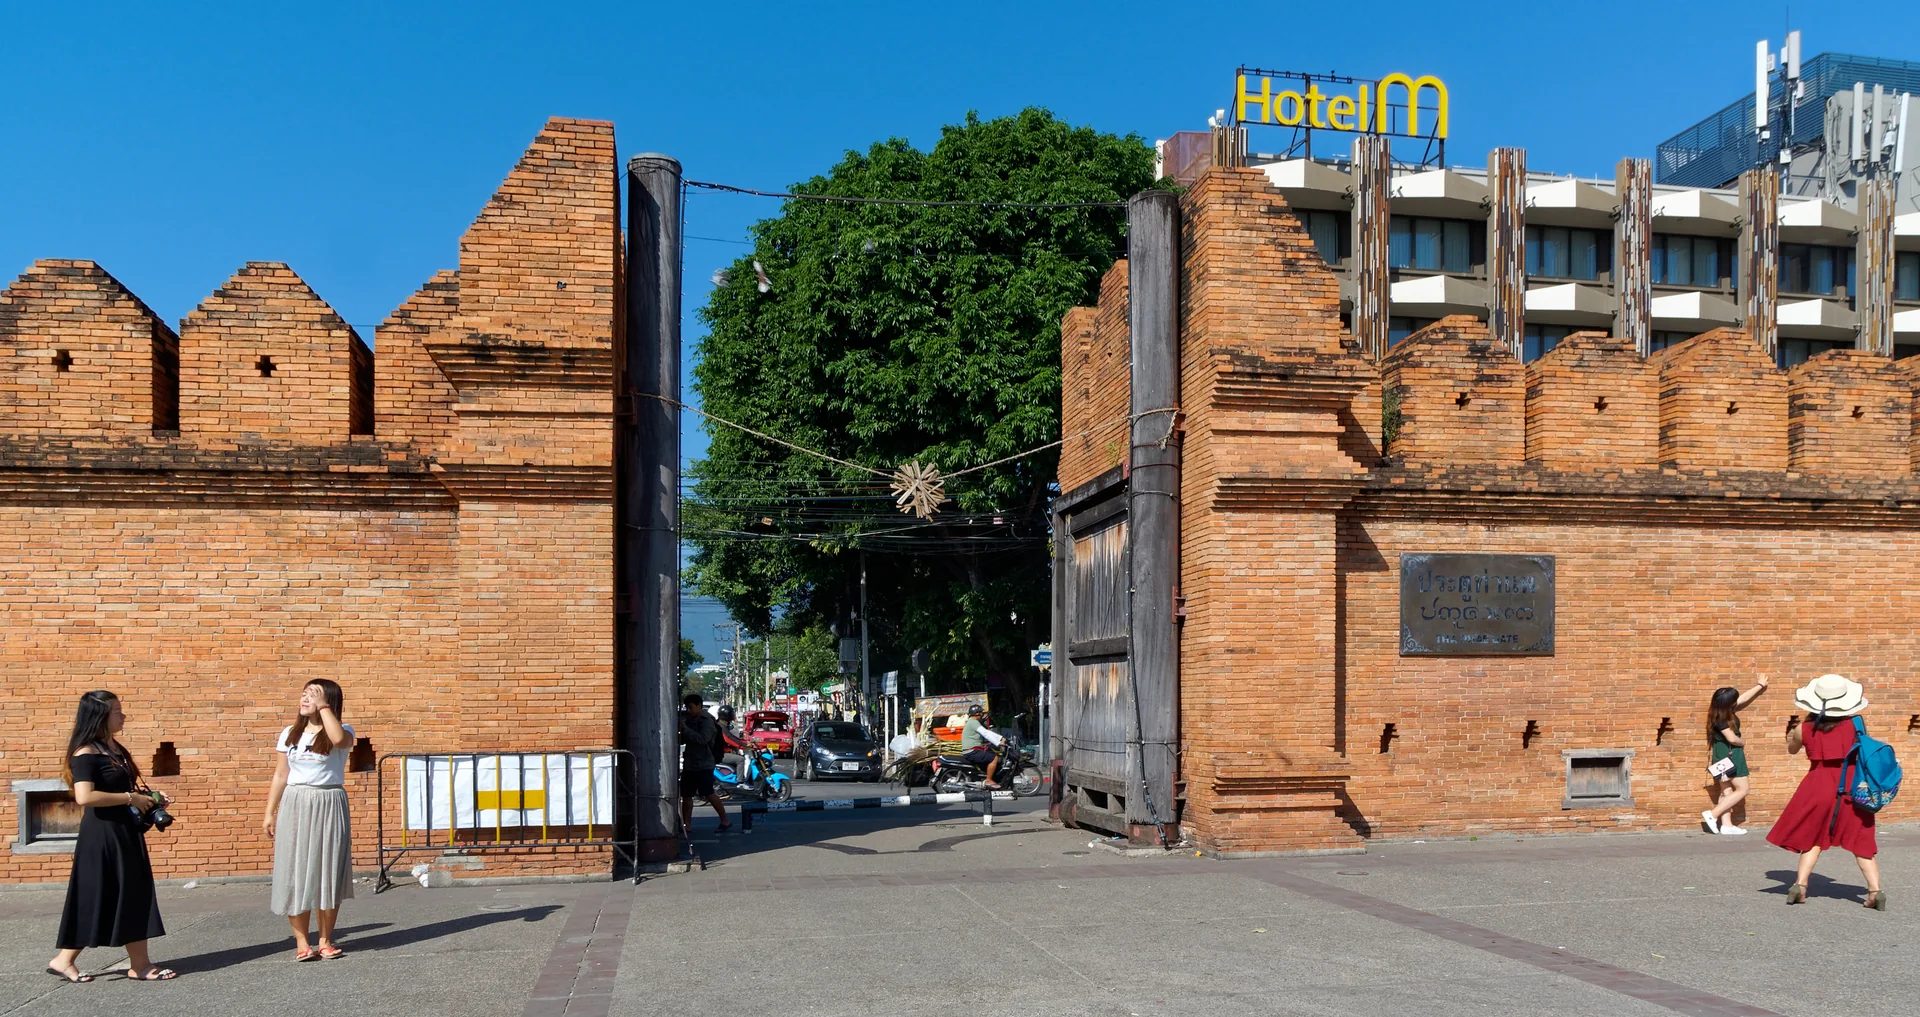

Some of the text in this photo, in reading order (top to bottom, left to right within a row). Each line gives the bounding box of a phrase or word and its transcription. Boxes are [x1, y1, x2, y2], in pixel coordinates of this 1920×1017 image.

[1237, 74, 1368, 132] Hotel
[1436, 634, 1458, 644] THA
[1491, 634, 1519, 644] GATE
